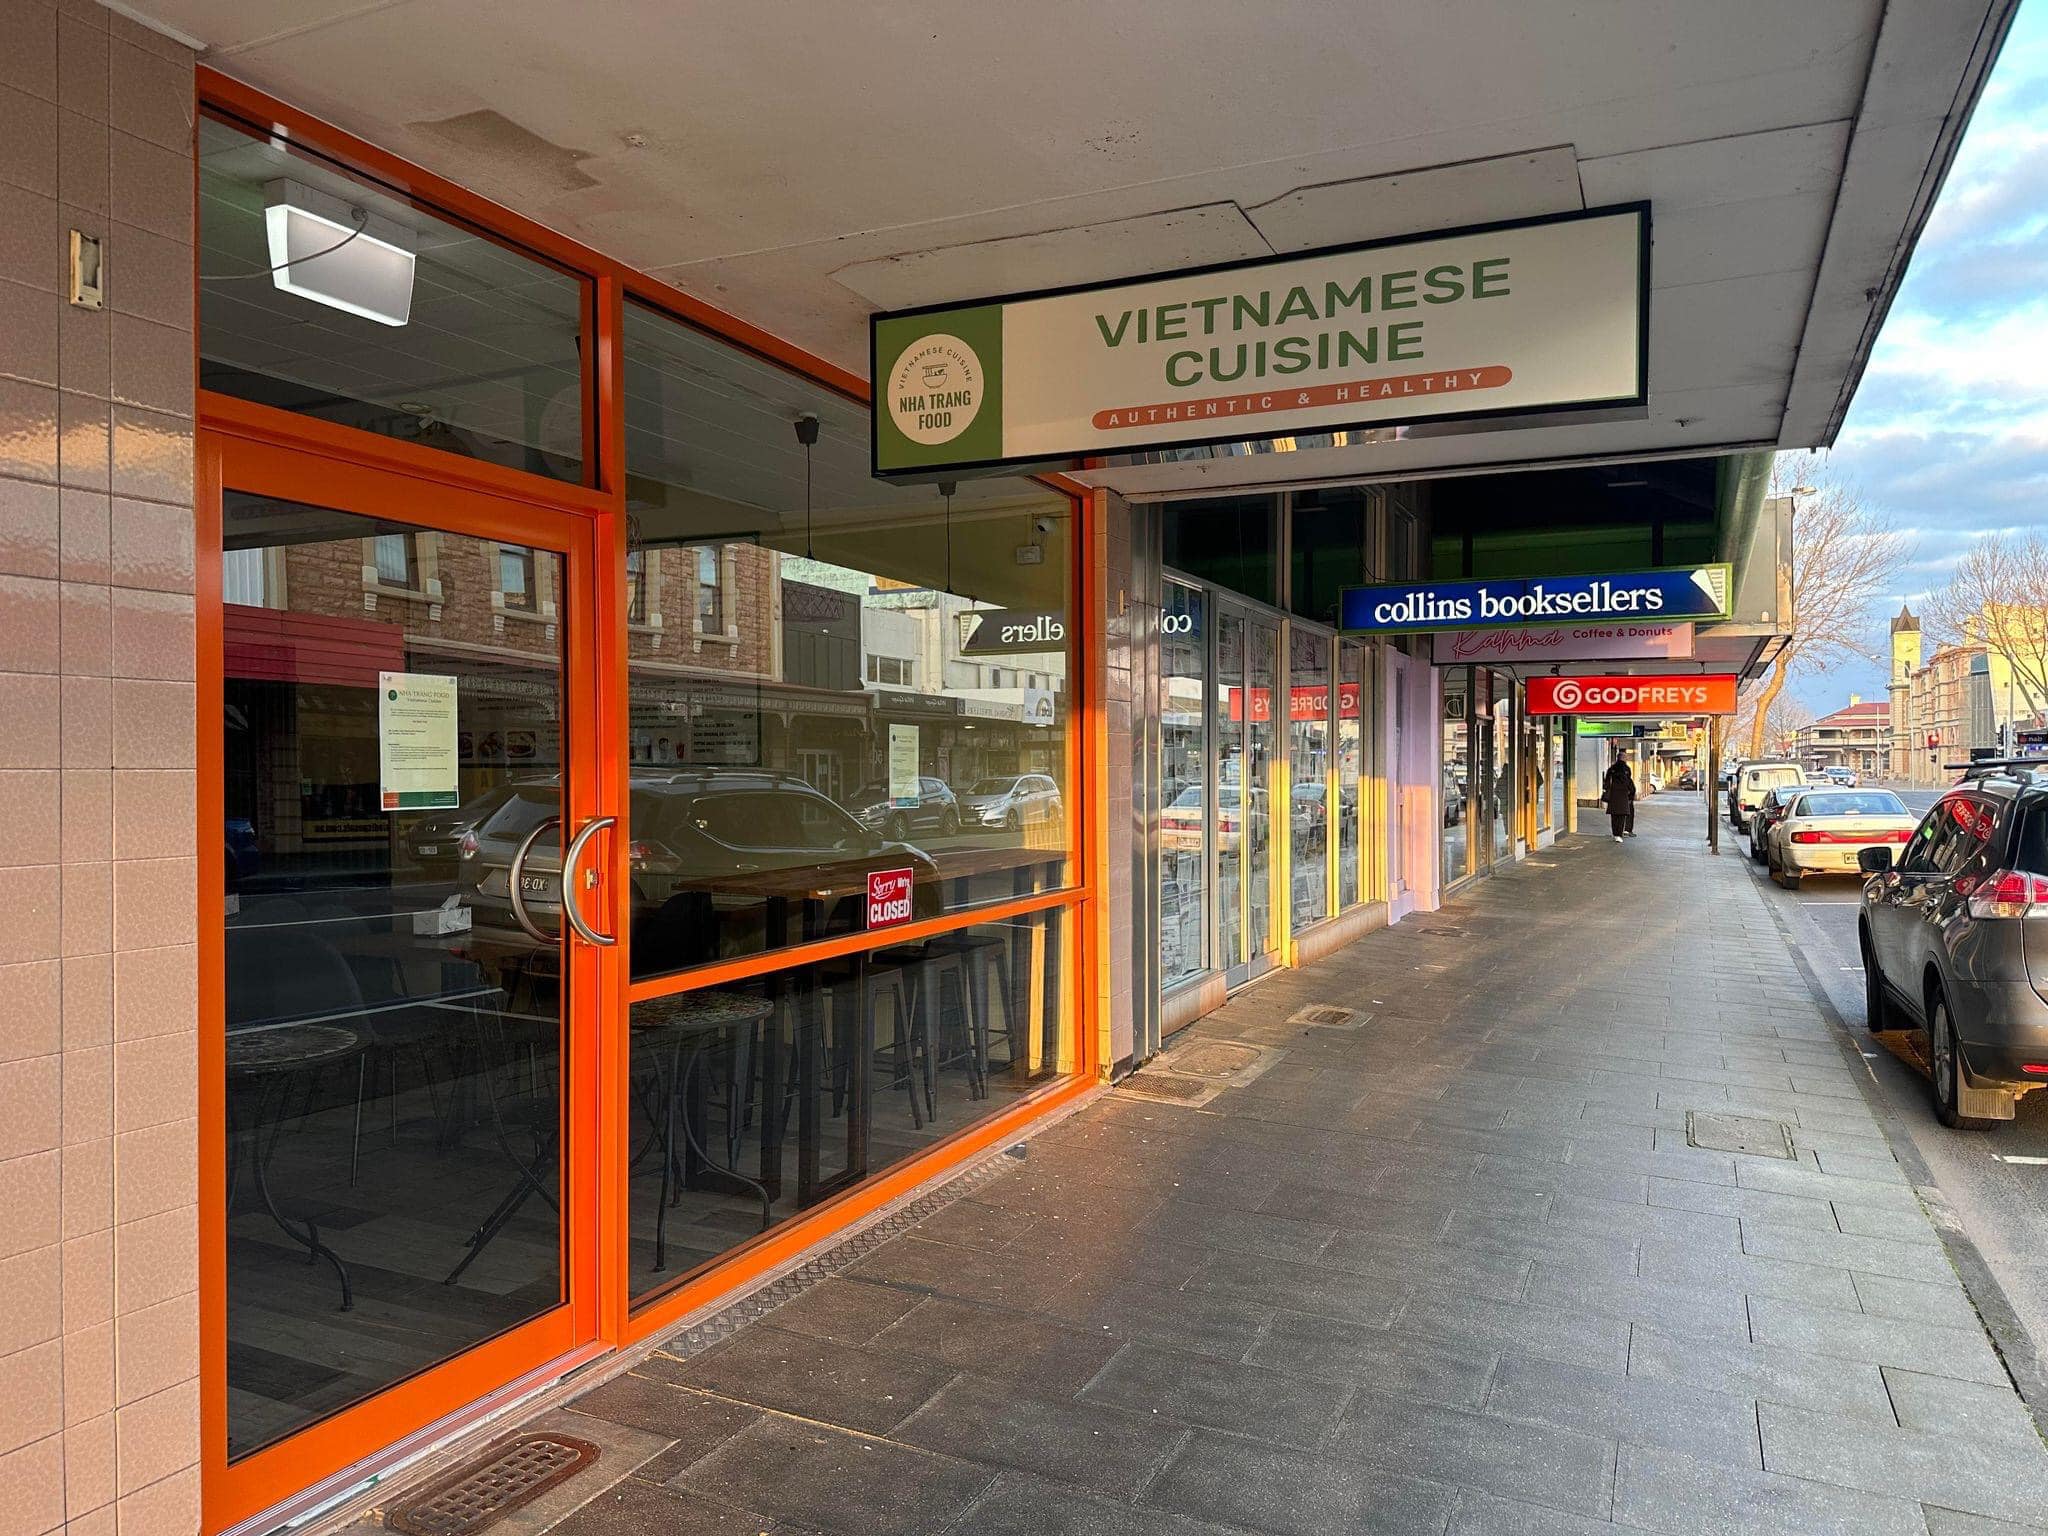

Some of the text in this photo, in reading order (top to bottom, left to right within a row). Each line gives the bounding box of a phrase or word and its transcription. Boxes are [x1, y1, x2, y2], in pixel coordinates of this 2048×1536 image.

[1095, 257, 1511, 348] VIETNAMESE
[1165, 320, 1425, 388] CUISINE
[898, 346, 973, 389] VIETNAMESE CUISINE
[900, 390, 971, 413] NHA TRANG
[1108, 371, 1485, 427] AUTHENTIC & HEALTHY
[918, 412, 952, 430] FOOD
[1374, 581, 1663, 624] collins booksellers
[1572, 629, 1613, 638] Coffee
[1616, 628, 1625, 637] &
[1628, 627, 1673, 637] Donuts
[1585, 686, 1708, 705] GODFREYS
[872, 877, 896, 899] Sorry
[870, 899, 910, 923] CLOSED
